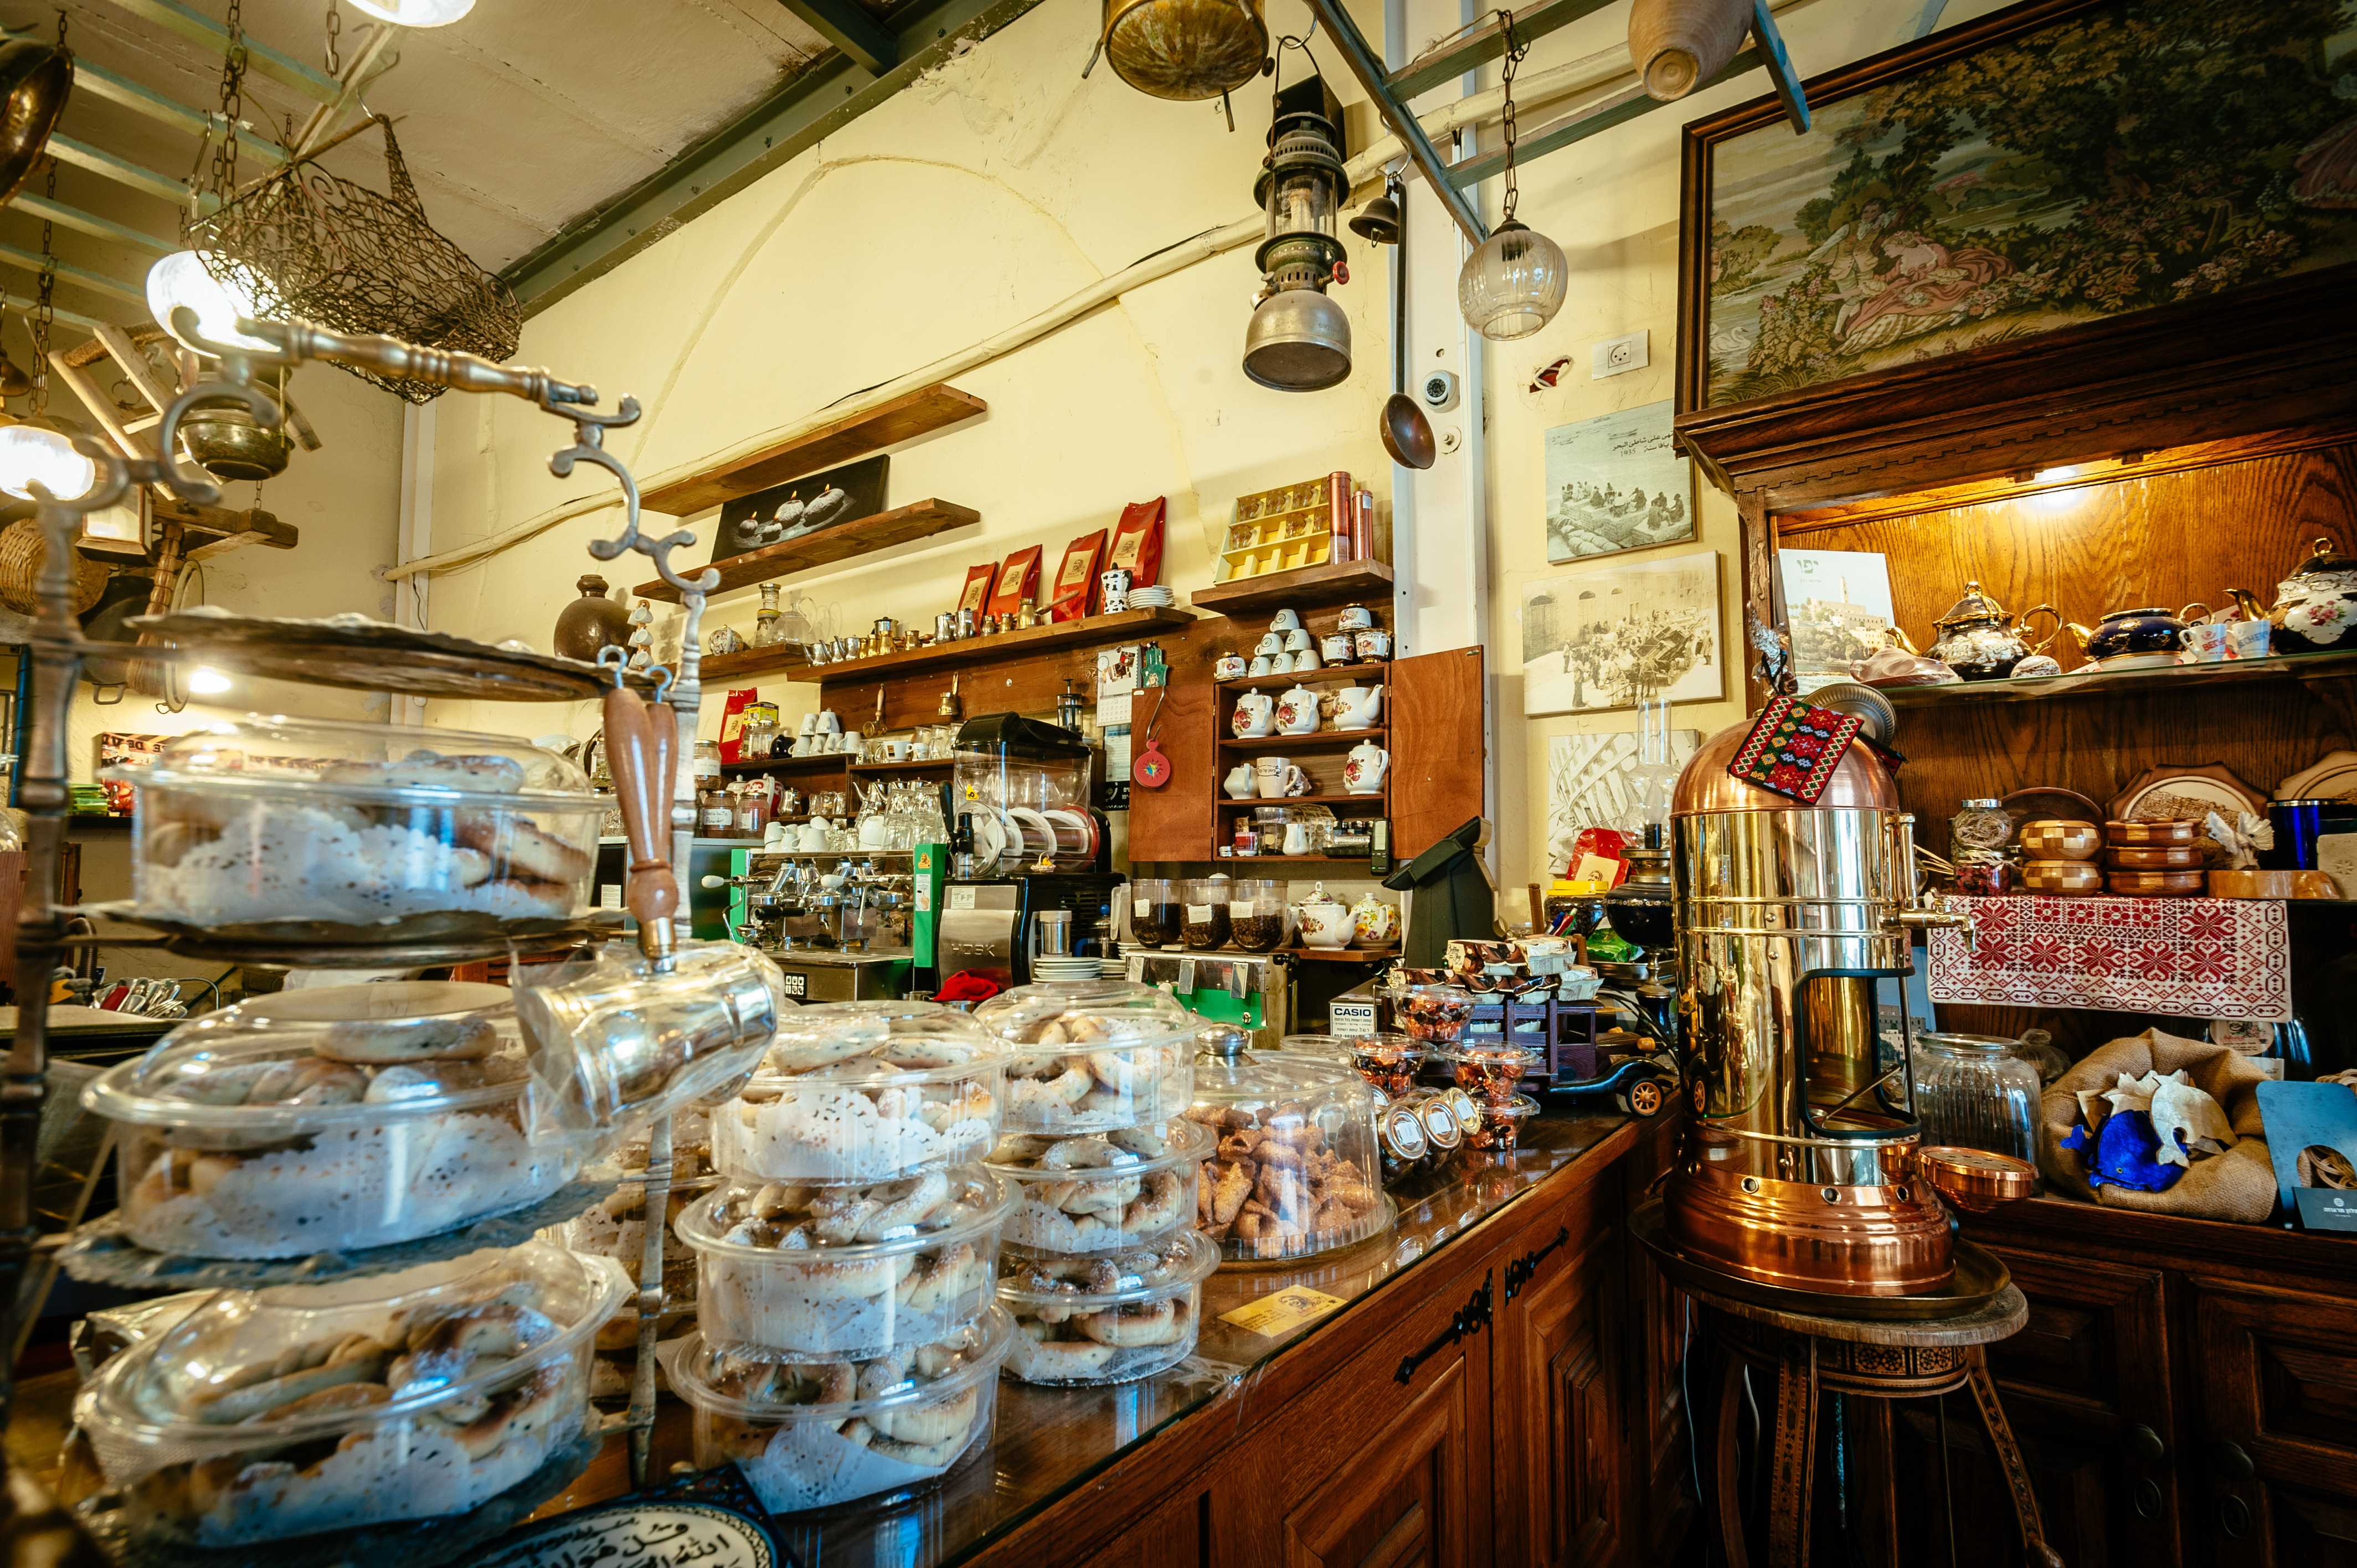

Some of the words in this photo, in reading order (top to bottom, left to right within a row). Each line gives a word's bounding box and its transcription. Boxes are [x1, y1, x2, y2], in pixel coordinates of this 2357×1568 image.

[1648, 435, 1660, 443] على
[1613, 441, 1628, 451] البحر
[1620, 448, 1636, 457] 1935
[1797, 559, 1819, 574] יפו
[1334, 1008, 1371, 1017] CASIO
[1438, 1115, 1444, 1126] 18
[1404, 1124, 1412, 1136] 18
